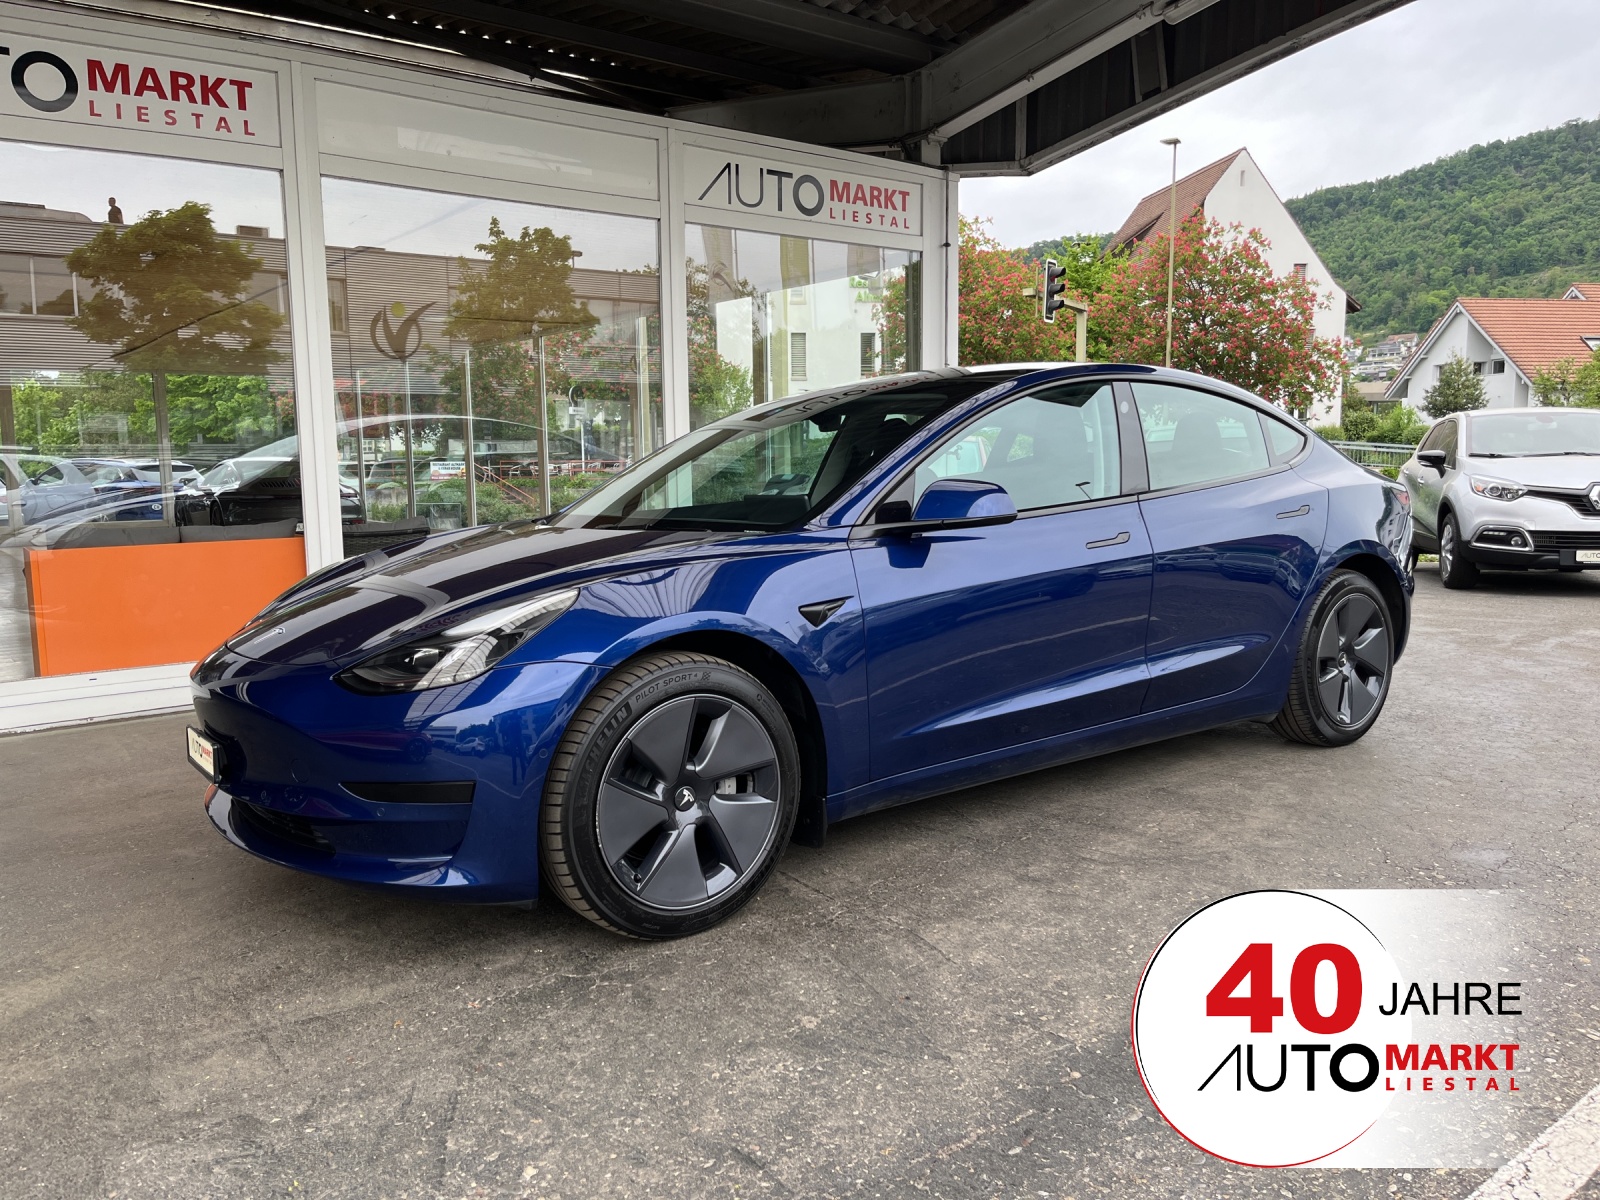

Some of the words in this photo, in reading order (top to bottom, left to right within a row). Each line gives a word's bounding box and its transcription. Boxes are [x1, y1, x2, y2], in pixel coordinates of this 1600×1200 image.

[0, 46, 79, 113] O
[87, 58, 253, 111] MARKT
[88, 99, 256, 137] LIESTAL
[698, 162, 825, 217] AUTO
[829, 179, 910, 212] MARKT
[829, 207, 910, 229] LIESTAL
[635, 682, 661, 703] PILOT
[663, 673, 693, 687] SPORT
